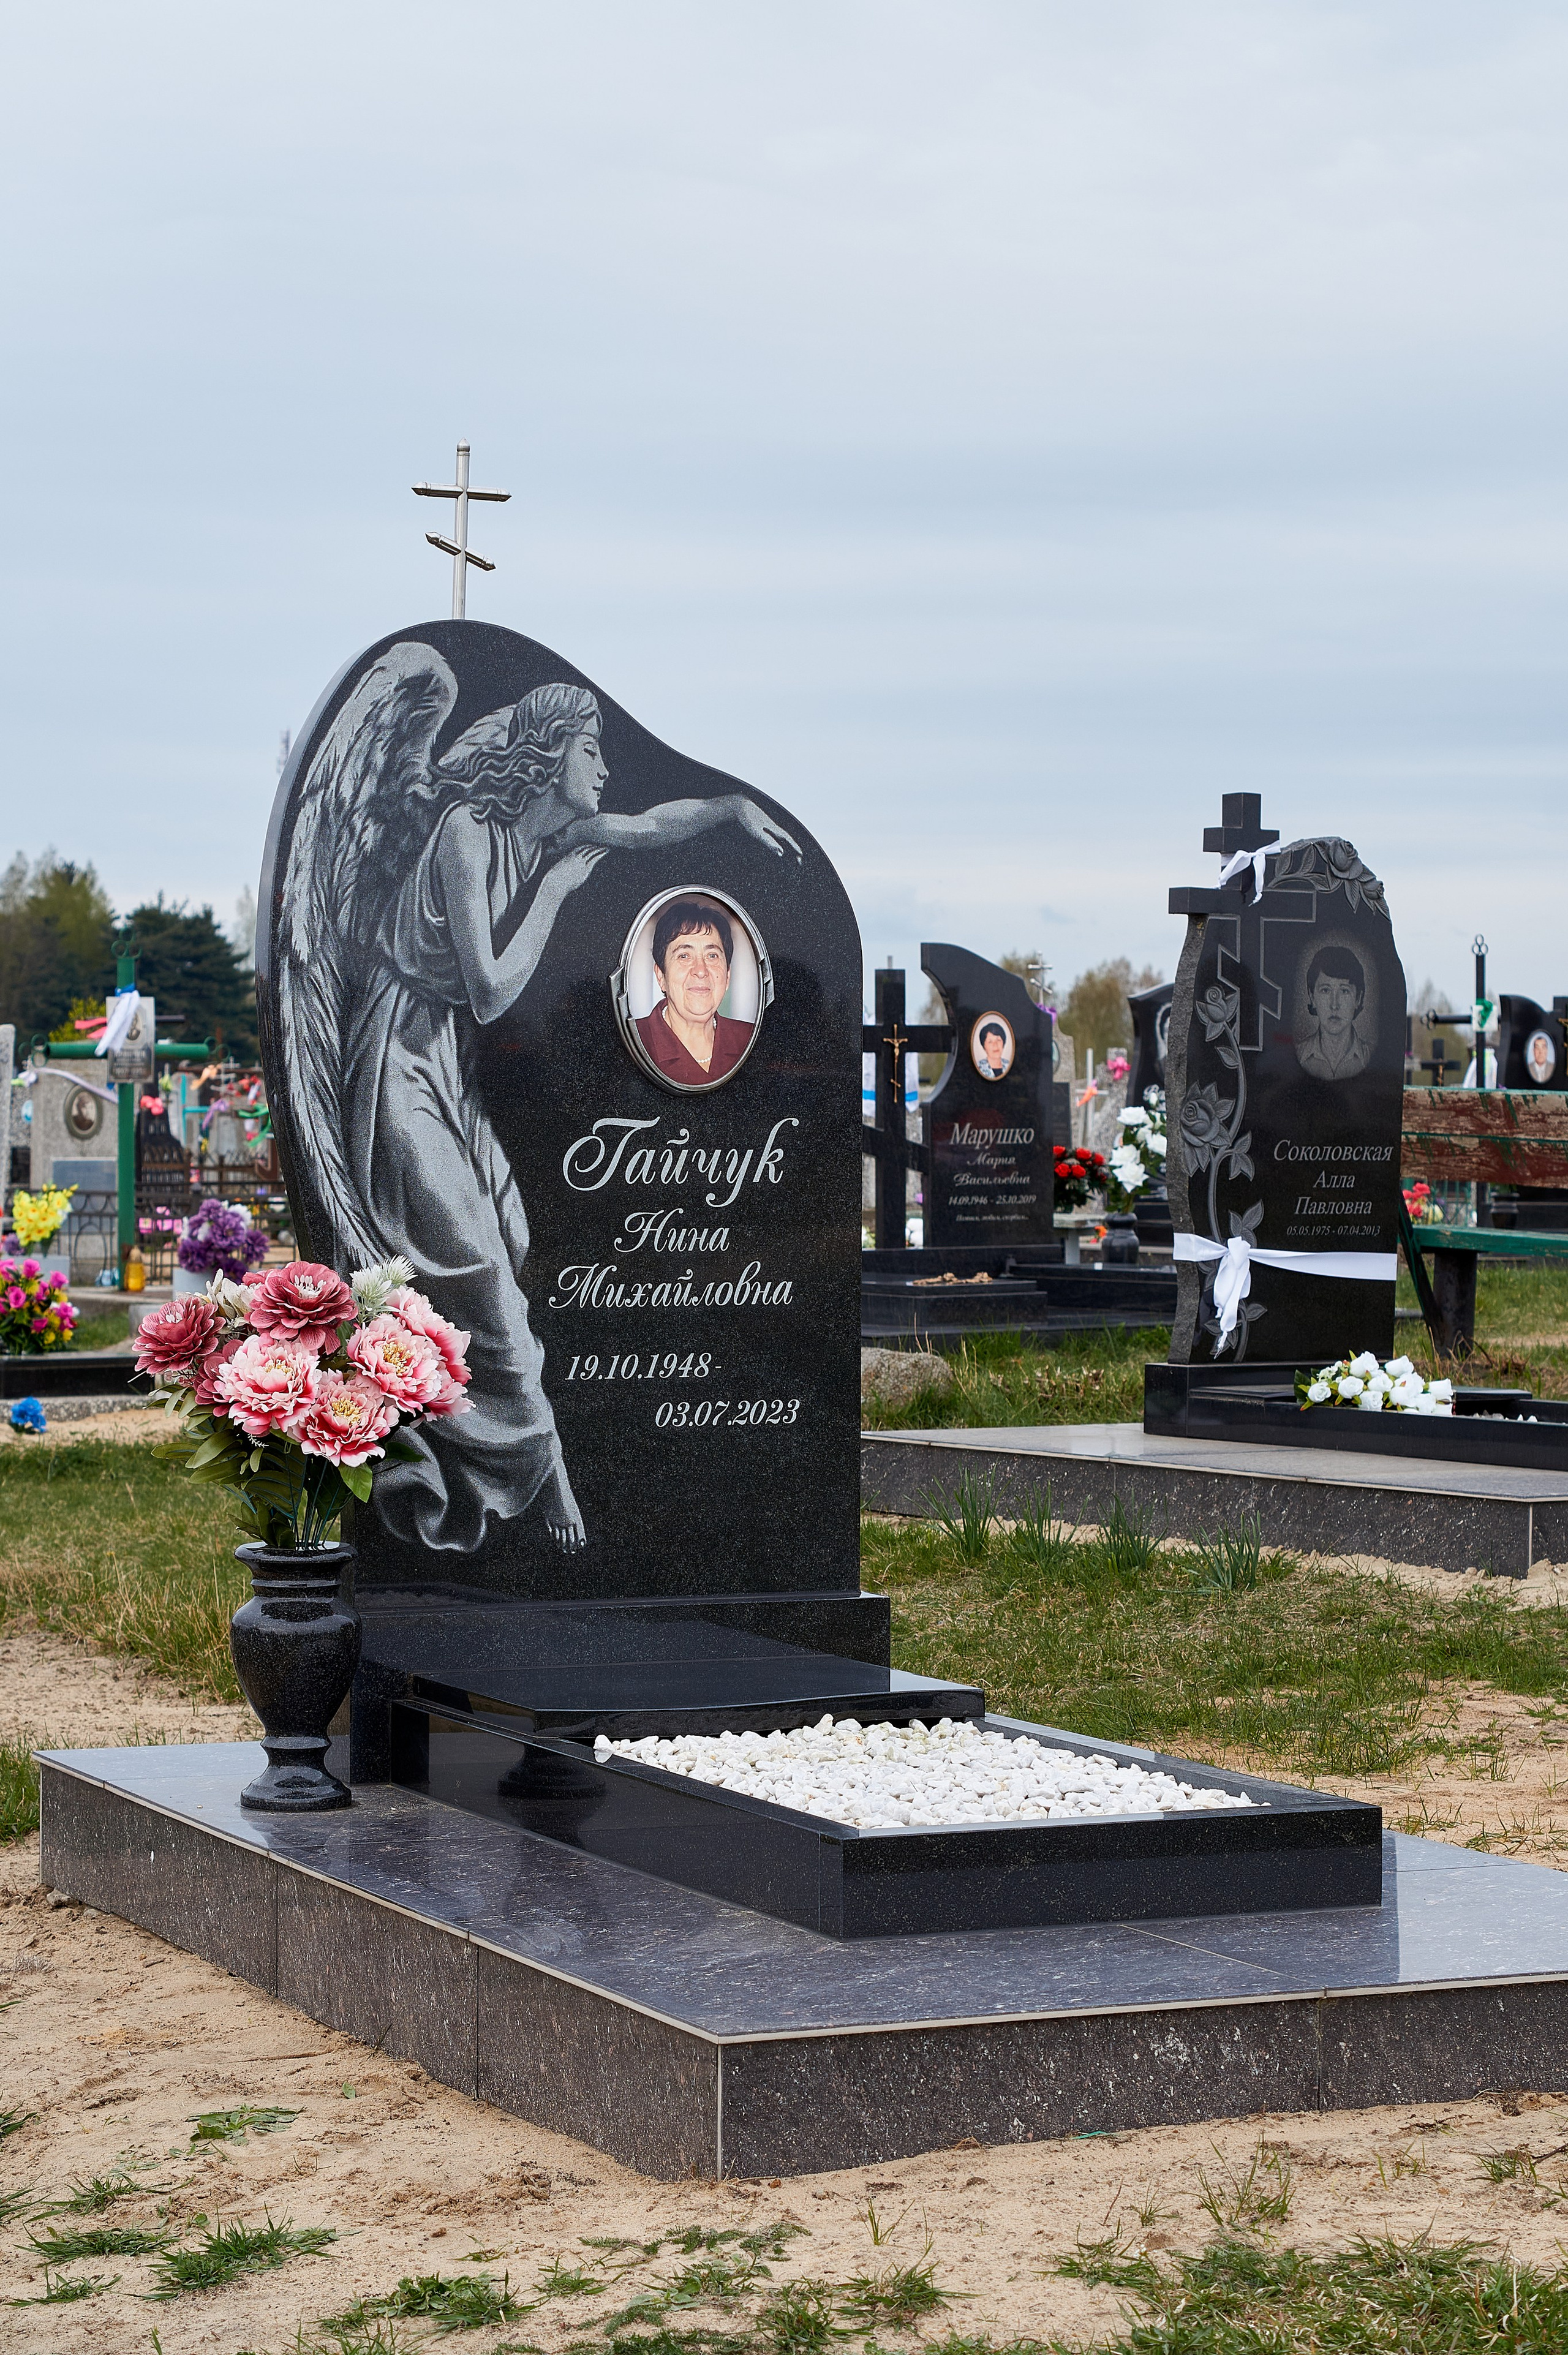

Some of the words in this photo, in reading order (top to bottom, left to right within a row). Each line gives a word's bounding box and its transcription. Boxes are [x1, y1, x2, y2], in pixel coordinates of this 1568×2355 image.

[949, 1122, 1035, 1149] Марушко
[966, 1153, 1016, 1169] Мария
[1273, 1139, 1393, 1161] Соколовская
[563, 1116, 799, 1207] Гайчук
[953, 1171, 1031, 1187] Васильевна
[1313, 1170, 1355, 1188] Алла
[1294, 1196, 1373, 1215] Павловна
[614, 1208, 730, 1253] Нина
[1286, 1226, 1330, 1235] 05.05.1975
[548, 1260, 794, 1309] Михайловна
[655, 1399, 801, 1427] 03.07.2023
